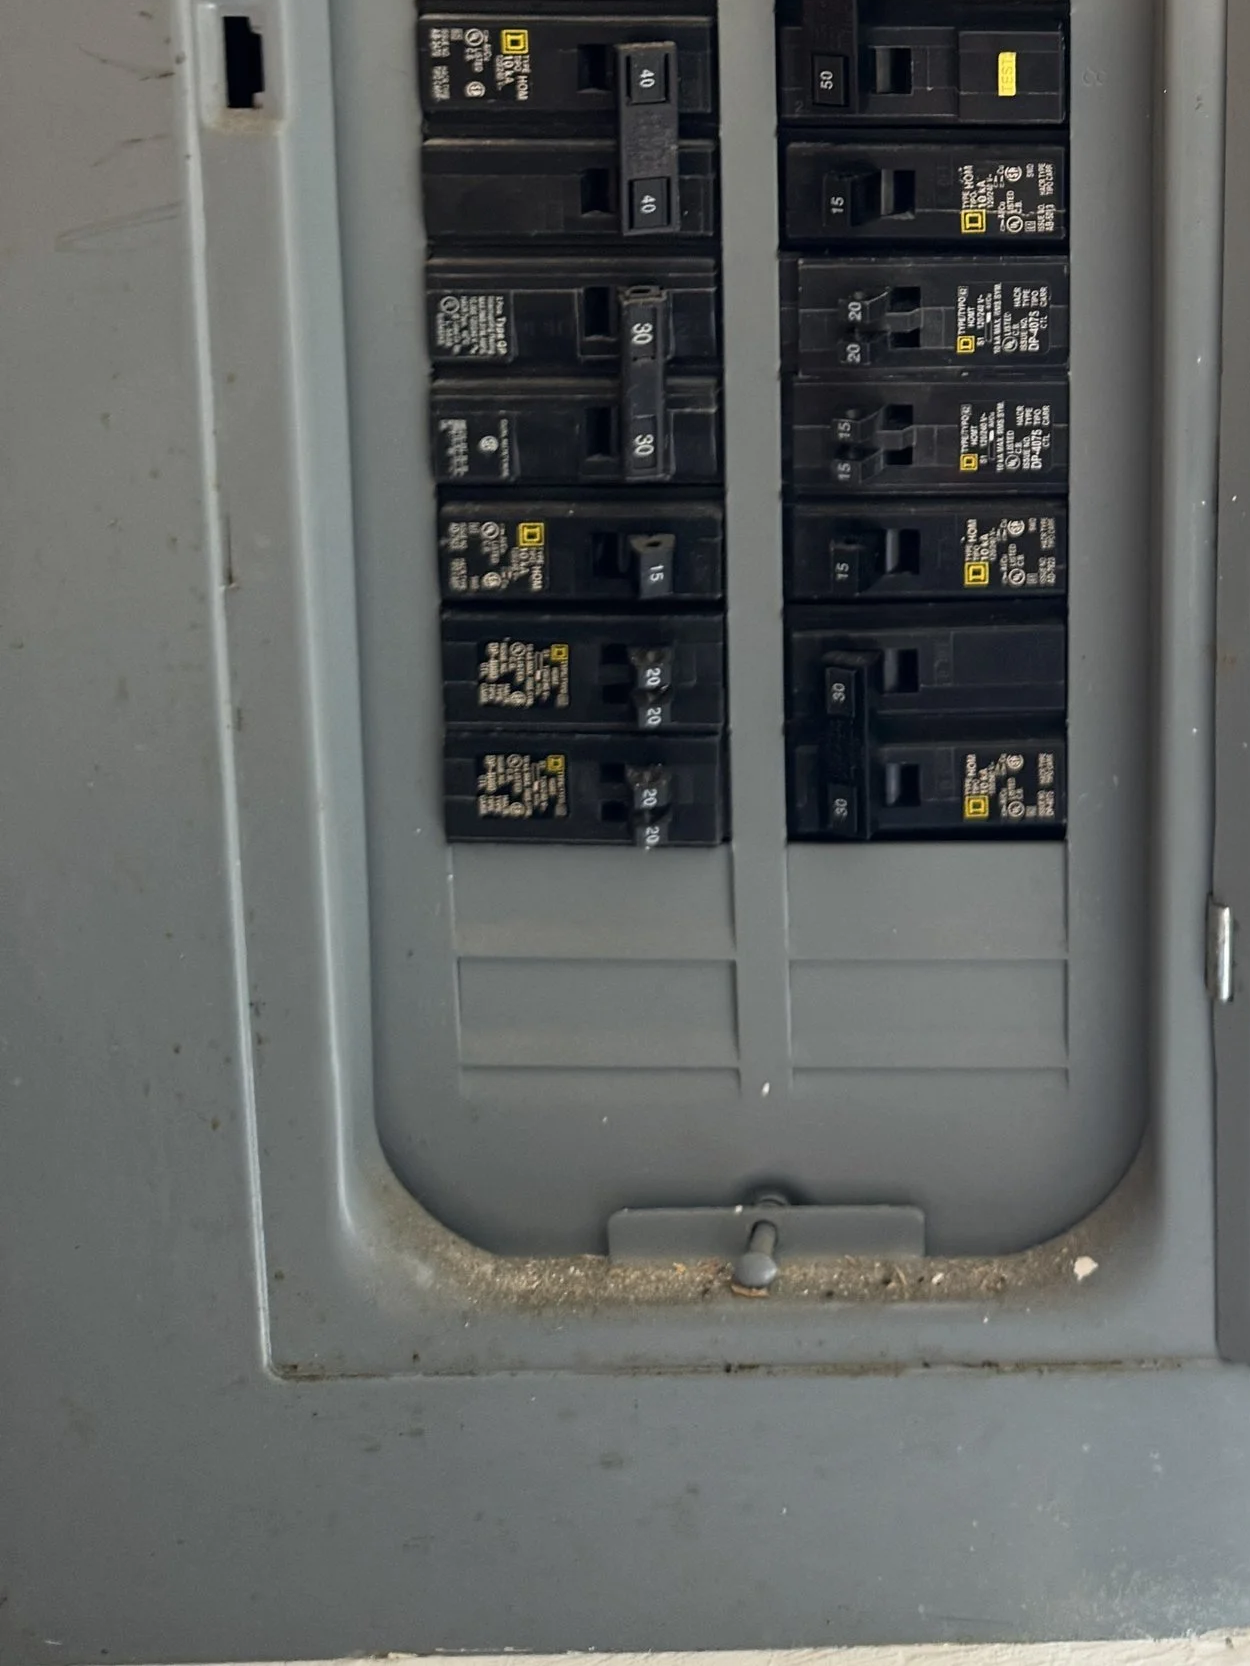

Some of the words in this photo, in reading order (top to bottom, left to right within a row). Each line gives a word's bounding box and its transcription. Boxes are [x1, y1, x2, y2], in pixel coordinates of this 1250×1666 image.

[639, 68, 655, 89] 40
[820, 70, 834, 90] 50
[640, 194, 656, 214] 40
[831, 196, 845, 215] 15
[849, 302, 862, 320] 20
[632, 321, 653, 345] 30
[633, 433, 654, 456] 30
[650, 564, 663, 583] 15
[647, 667, 661, 686] 20
[833, 682, 846, 702] 30
[643, 789, 658, 808] 20
